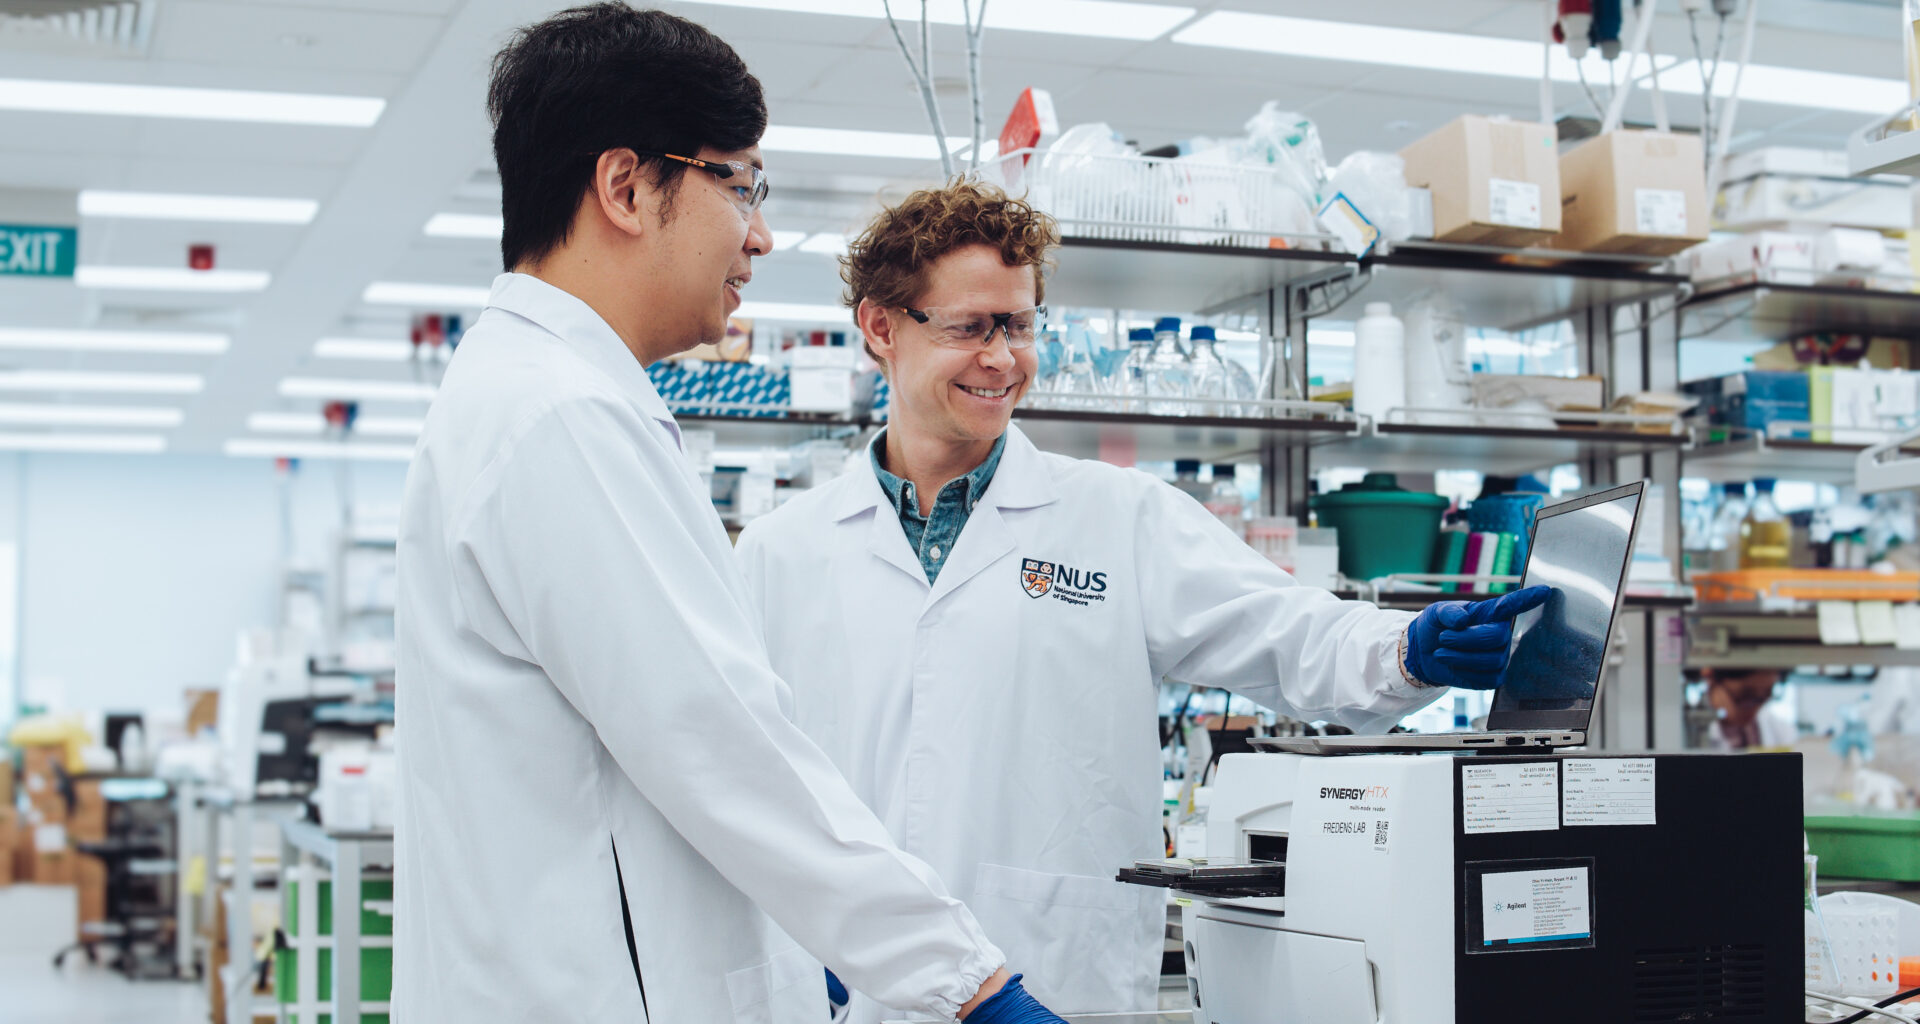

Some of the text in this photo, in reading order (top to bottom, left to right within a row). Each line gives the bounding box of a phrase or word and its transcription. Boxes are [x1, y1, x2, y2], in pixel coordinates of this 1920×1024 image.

[1057, 564, 1107, 592] NUS
[1054, 585, 1105, 602] National University
[1060, 595, 1088, 606] Singapore
[1320, 786, 1389, 800] SYNERGY HTX
[1323, 822, 1366, 834] FREDENS LAB
